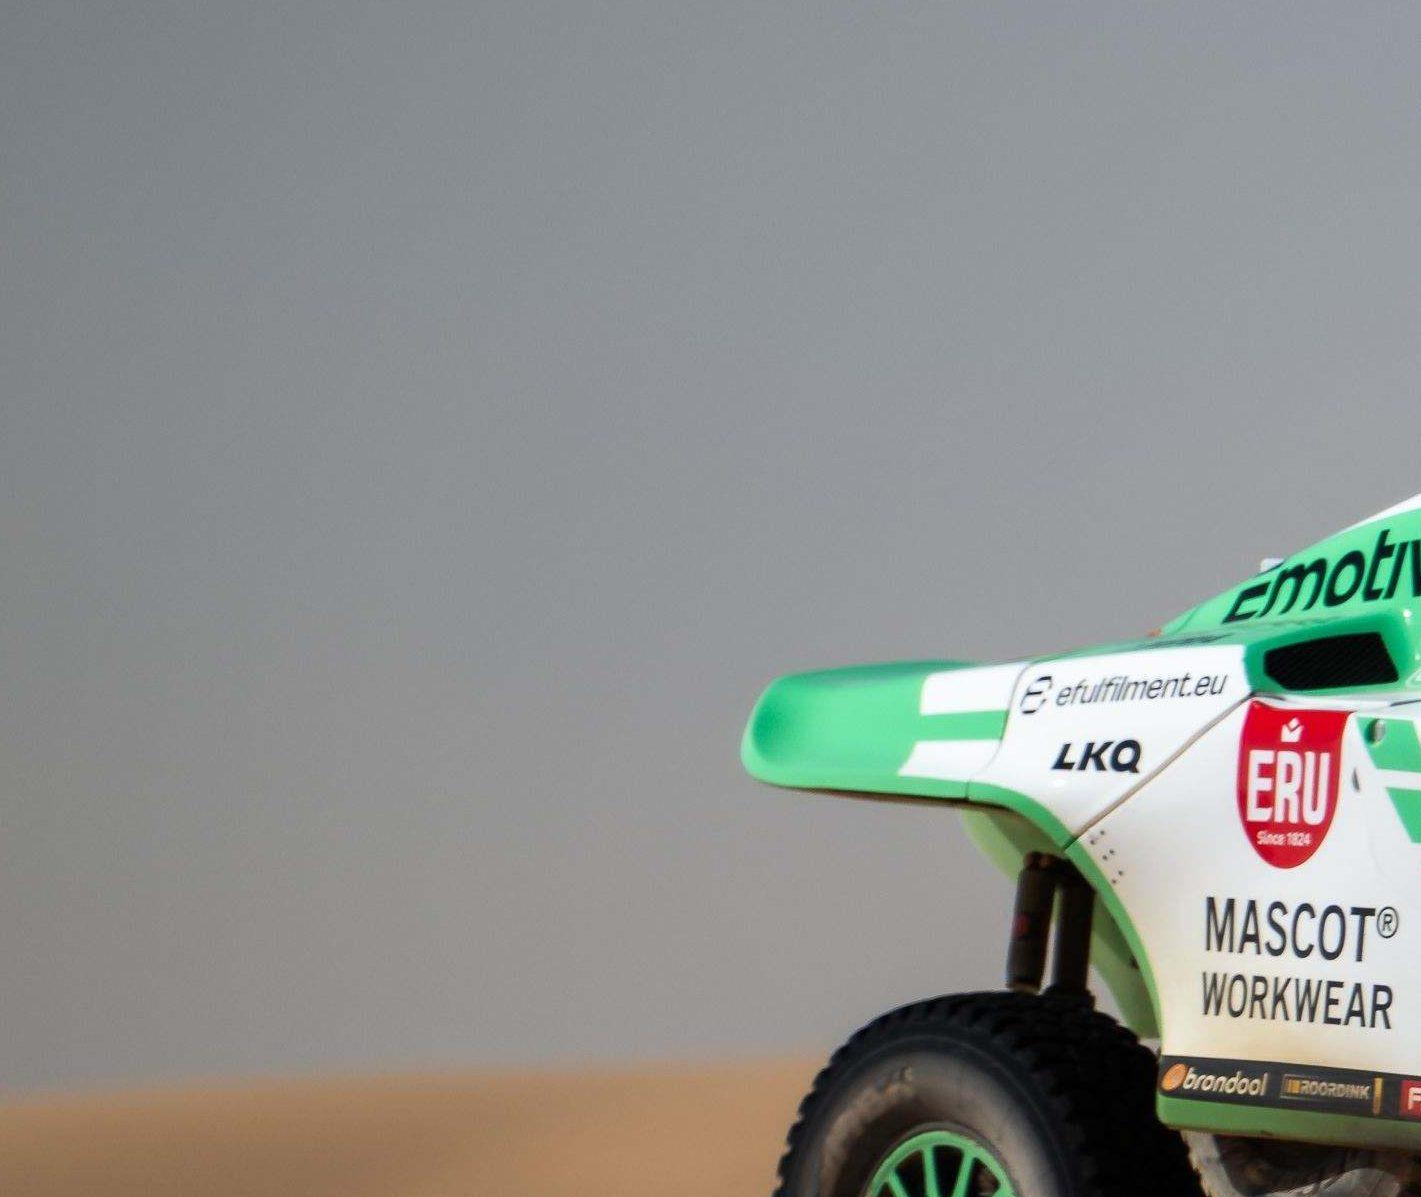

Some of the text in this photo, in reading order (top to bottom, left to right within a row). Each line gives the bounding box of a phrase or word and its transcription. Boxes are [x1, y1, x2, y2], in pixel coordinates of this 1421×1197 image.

[1055, 672, 1229, 706] efulfilment.eu
[1052, 739, 1142, 773] LKQ
[1247, 750, 1331, 824] ERU
[1201, 971, 1394, 1031] WORKWEAR
